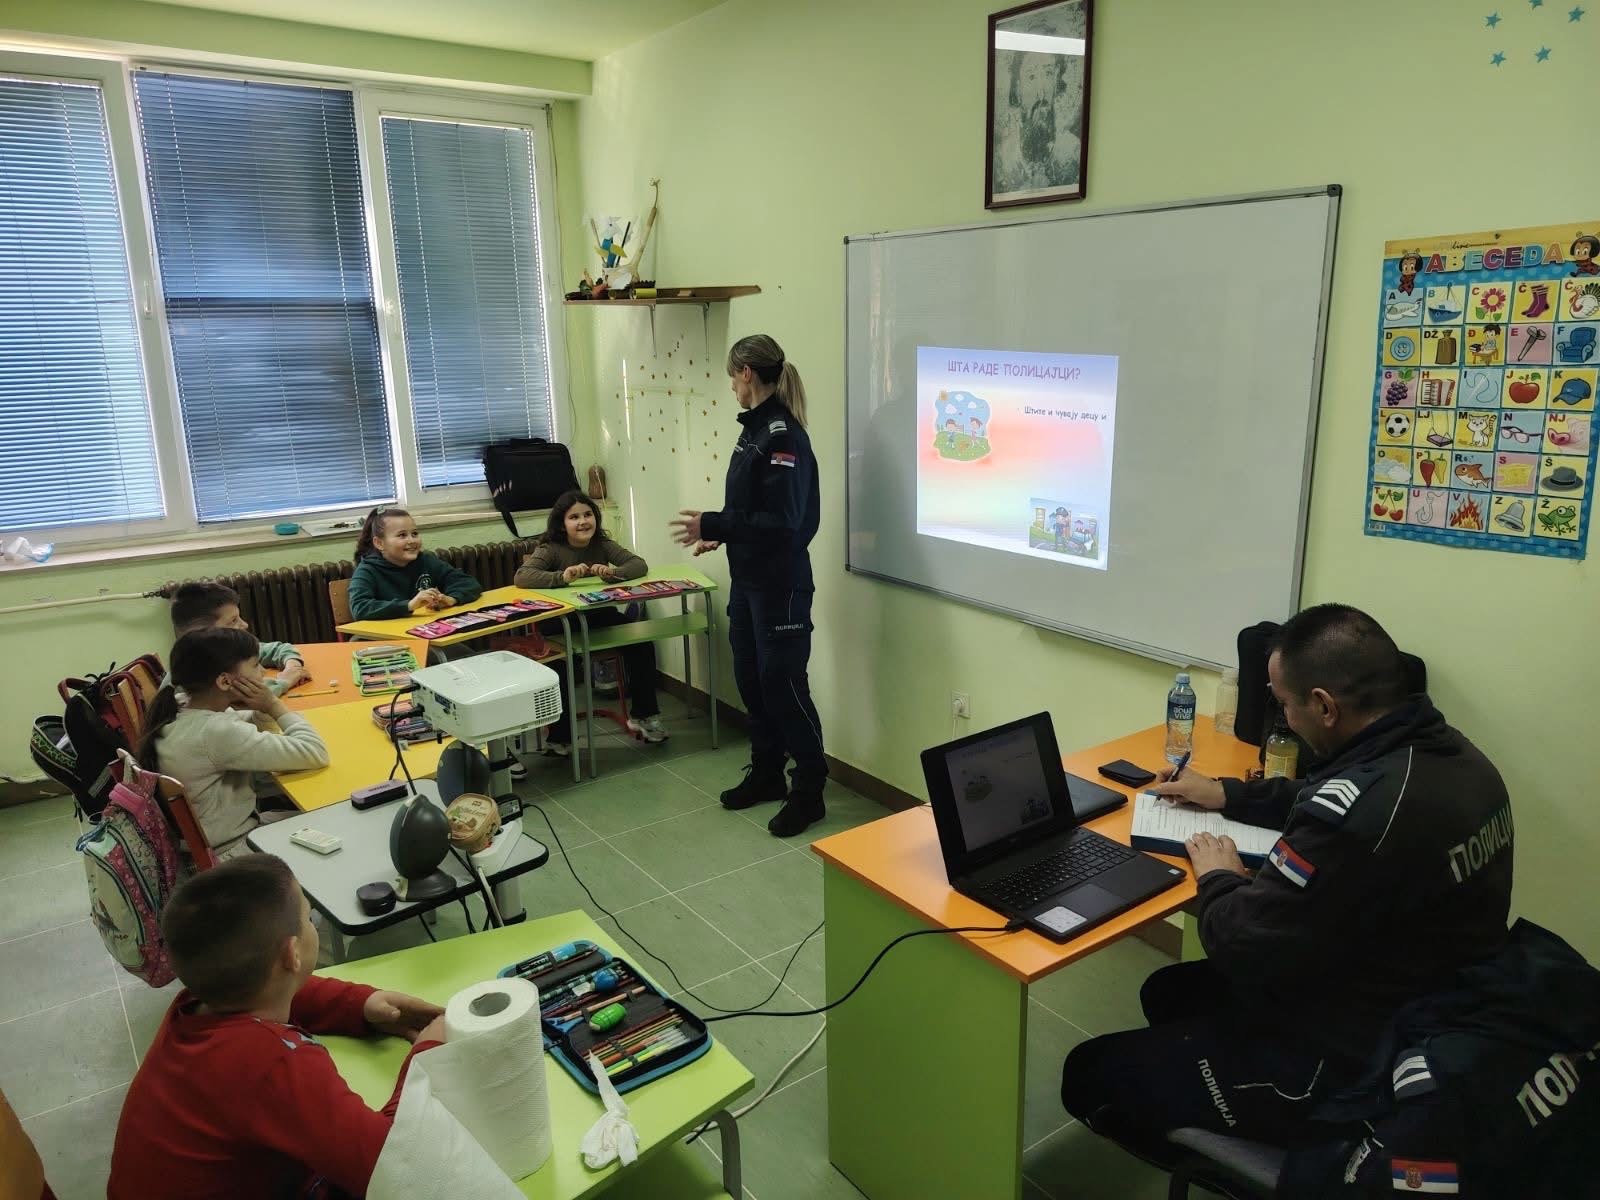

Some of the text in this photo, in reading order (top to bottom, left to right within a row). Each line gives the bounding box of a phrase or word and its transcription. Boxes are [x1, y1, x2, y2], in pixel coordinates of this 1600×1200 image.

[1425, 241, 1565, 273] ABECEDA
[1388, 292, 1396, 300] A
[1428, 290, 1435, 298] B
[1471, 287, 1480, 296] C
[1424, 330, 1438, 339] DŽ
[1510, 328, 1519, 337] E
[1557, 326, 1565, 335] F
[1386, 331, 1392, 340] D
[948, 360, 1081, 381] ШТА РАДЕ ПОЛИЦАЈЦИ?
[1384, 370, 1392, 379] G
[1422, 371, 1430, 379] H
[1506, 370, 1514, 379] J
[1554, 370, 1562, 379] K
[1024, 406, 1046, 416] Штите
[1380, 410, 1386, 418] L
[1417, 410, 1430, 419] LJ
[1458, 412, 1468, 420] M
[1504, 412, 1513, 421] N
[1549, 413, 1566, 422] NJ
[1378, 450, 1386, 458] O
[1416, 452, 1423, 460] P
[1499, 456, 1506, 464] S
[1375, 486, 1381, 494] T
[1412, 490, 1420, 498] U
[1453, 492, 1460, 500] V
[1495, 496, 1503, 504] Z
[1198, 1059, 1237, 1127] ПОЛИЦИЈА
